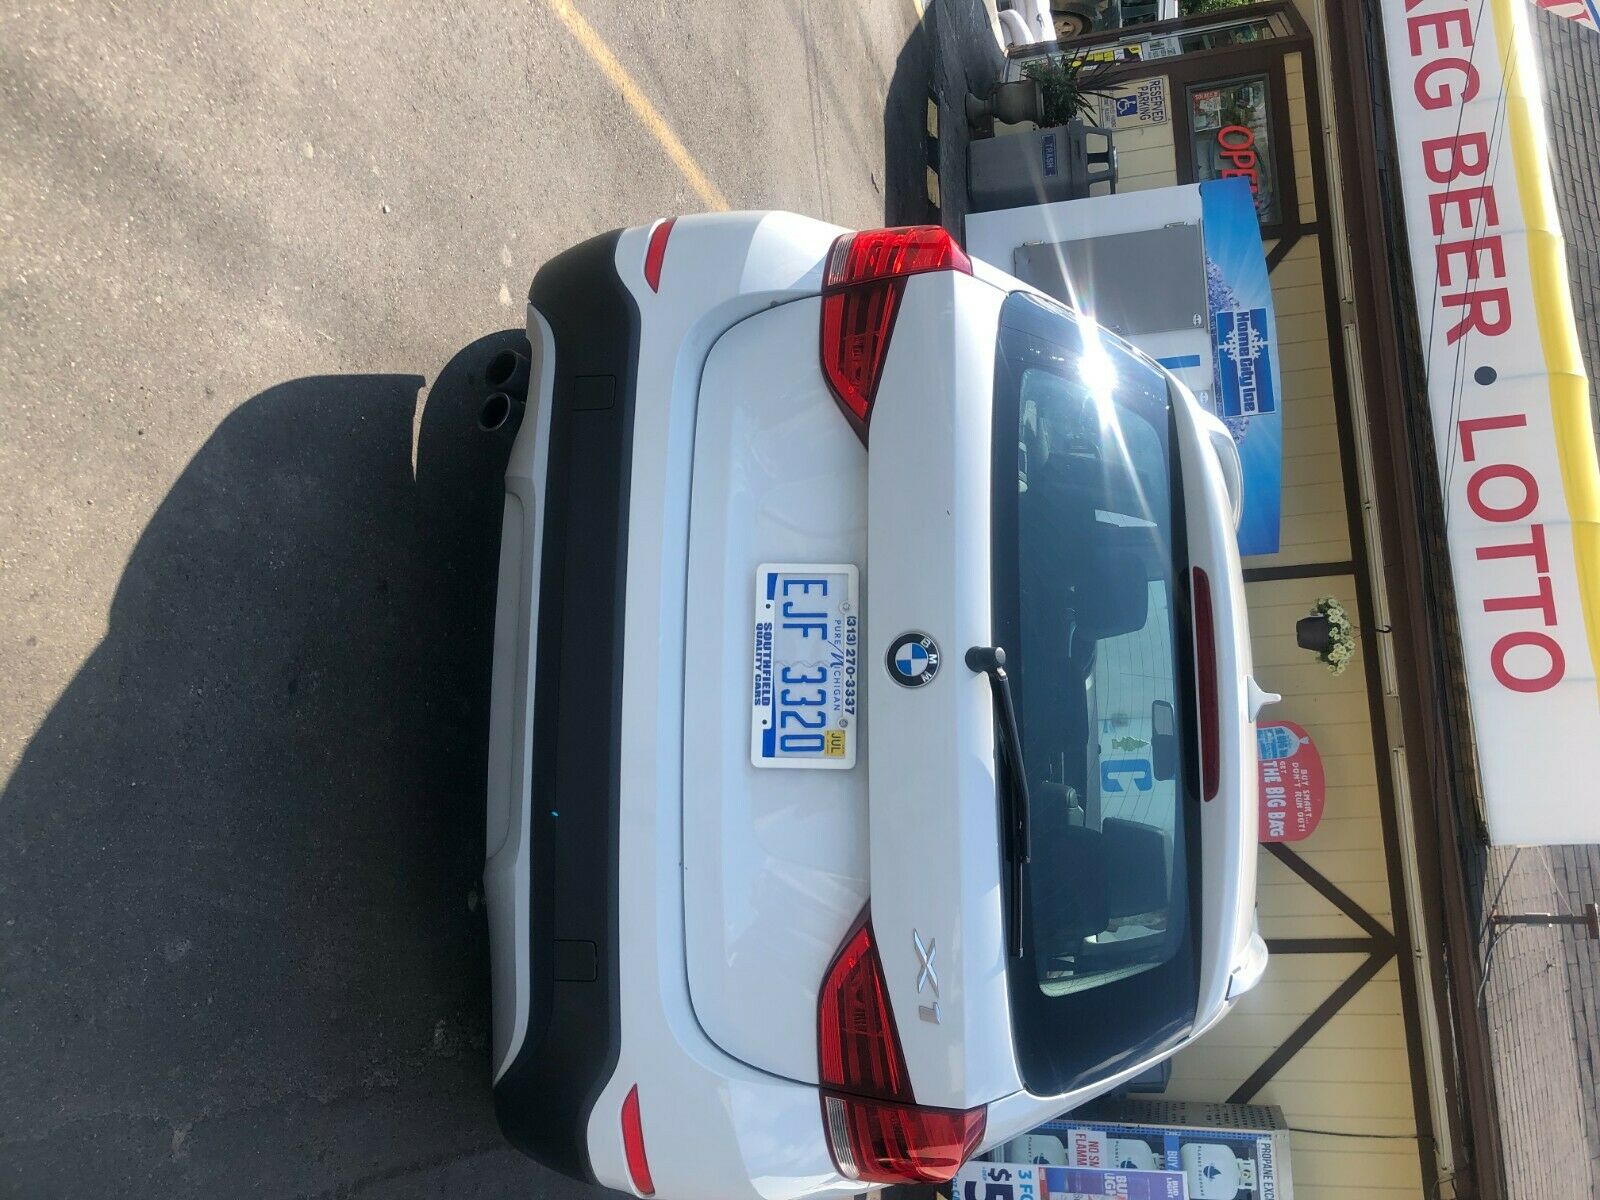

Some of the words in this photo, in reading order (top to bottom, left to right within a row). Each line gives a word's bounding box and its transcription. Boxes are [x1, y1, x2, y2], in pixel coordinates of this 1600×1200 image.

[1405, 0, 1481, 110] EG
[1138, 86, 1151, 121] PARKING
[1149, 80, 1165, 122] RESERVED
[1045, 143, 1054, 168] TRASH
[1217, 125, 1262, 209] OPE
[1421, 132, 1512, 346] BEER
[1237, 311, 1250, 356] Home
[1239, 358, 1255, 387] City
[1243, 388, 1256, 412] Ice
[1458, 414, 1566, 694] LOTTO
[782, 579, 828, 641] EJF
[834, 619, 842, 645] PURE
[845, 616, 857, 646] (313)
[754, 622, 763, 671] QUALITY
[920, 637, 938, 683] BMW
[761, 622, 773, 707] SOUTHFIELD
[827, 641, 844, 712] MICHIGAN
[753, 673, 762, 706] CARS
[844, 649, 856, 716] 270-3337
[780, 666, 827, 752] 3320
[831, 732, 842, 754] JUL
[1263, 761, 1281, 783] THE
[1292, 762, 1301, 787] DON'T
[1300, 769, 1309, 786] BUY
[1265, 786, 1287, 808] BIG
[1294, 791, 1303, 808] RUN
[1267, 812, 1286, 837] BAG
[1296, 812, 1305, 832] OUT!
[913, 927, 943, 1025] X1
[1076, 1133, 1087, 1166] FLAMM
[1088, 1141, 1099, 1153] NO
[1089, 1156, 1100, 1168] SM
[1167, 1150, 1179, 1168] BUY
[1261, 1143, 1273, 1180] PROPANE
[1018, 1169, 1033, 1180] 3
[1166, 1177, 1174, 1199] LIGHT
[1263, 1182, 1275, 1200] EXC
